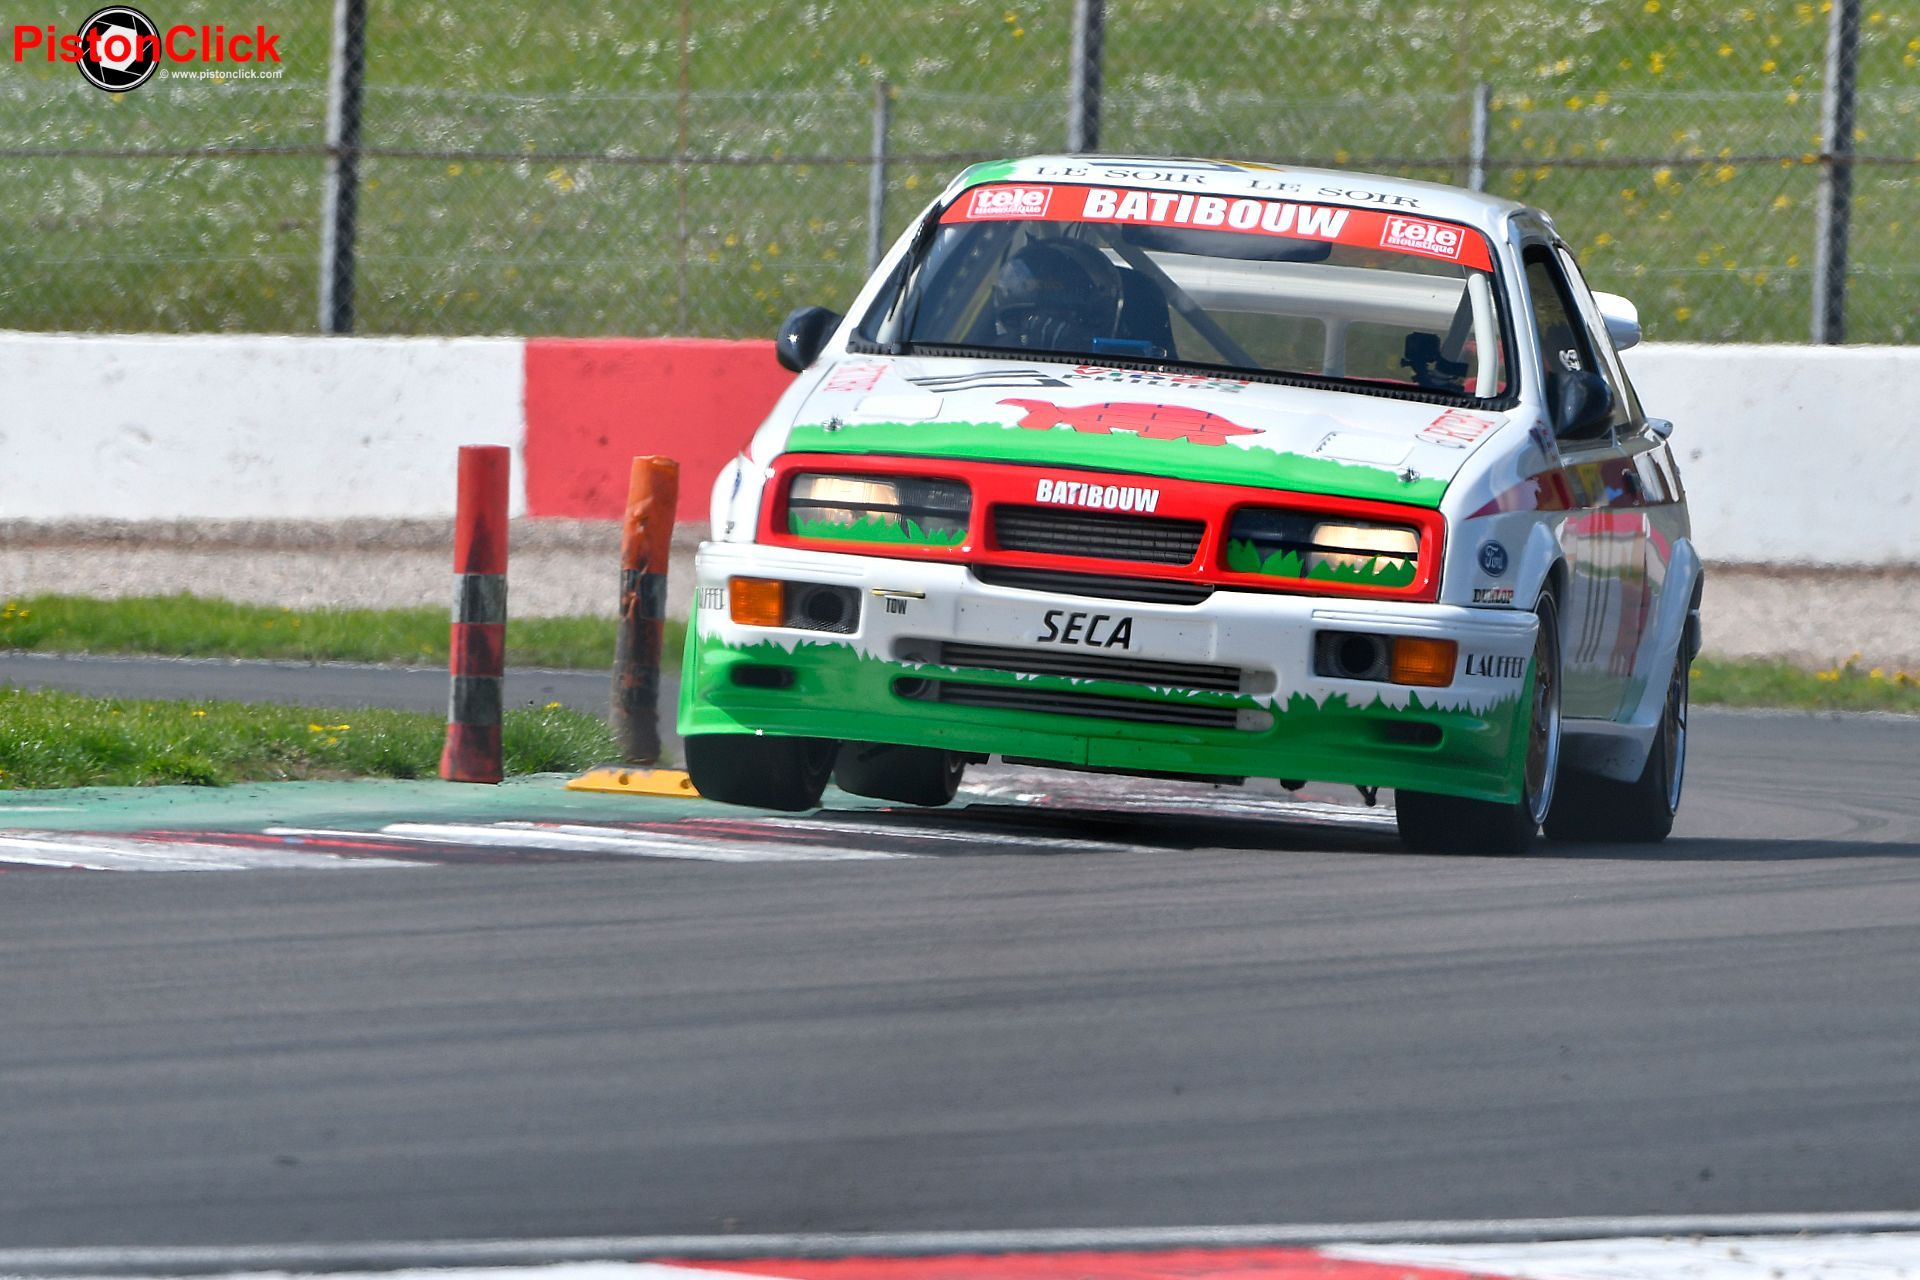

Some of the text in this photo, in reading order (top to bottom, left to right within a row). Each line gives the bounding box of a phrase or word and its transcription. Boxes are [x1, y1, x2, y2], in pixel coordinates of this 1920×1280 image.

[1037, 167, 1206, 185] LE SOIR
[978, 188, 1045, 208] tele
[1248, 179, 1422, 208] LE SOIR
[1082, 189, 1350, 238] BATIBOUW
[1391, 220, 1457, 246] tele
[1036, 478, 1160, 513] BATIBOUW
[886, 597, 908, 616] TOW
[1037, 610, 1133, 650] SECA
